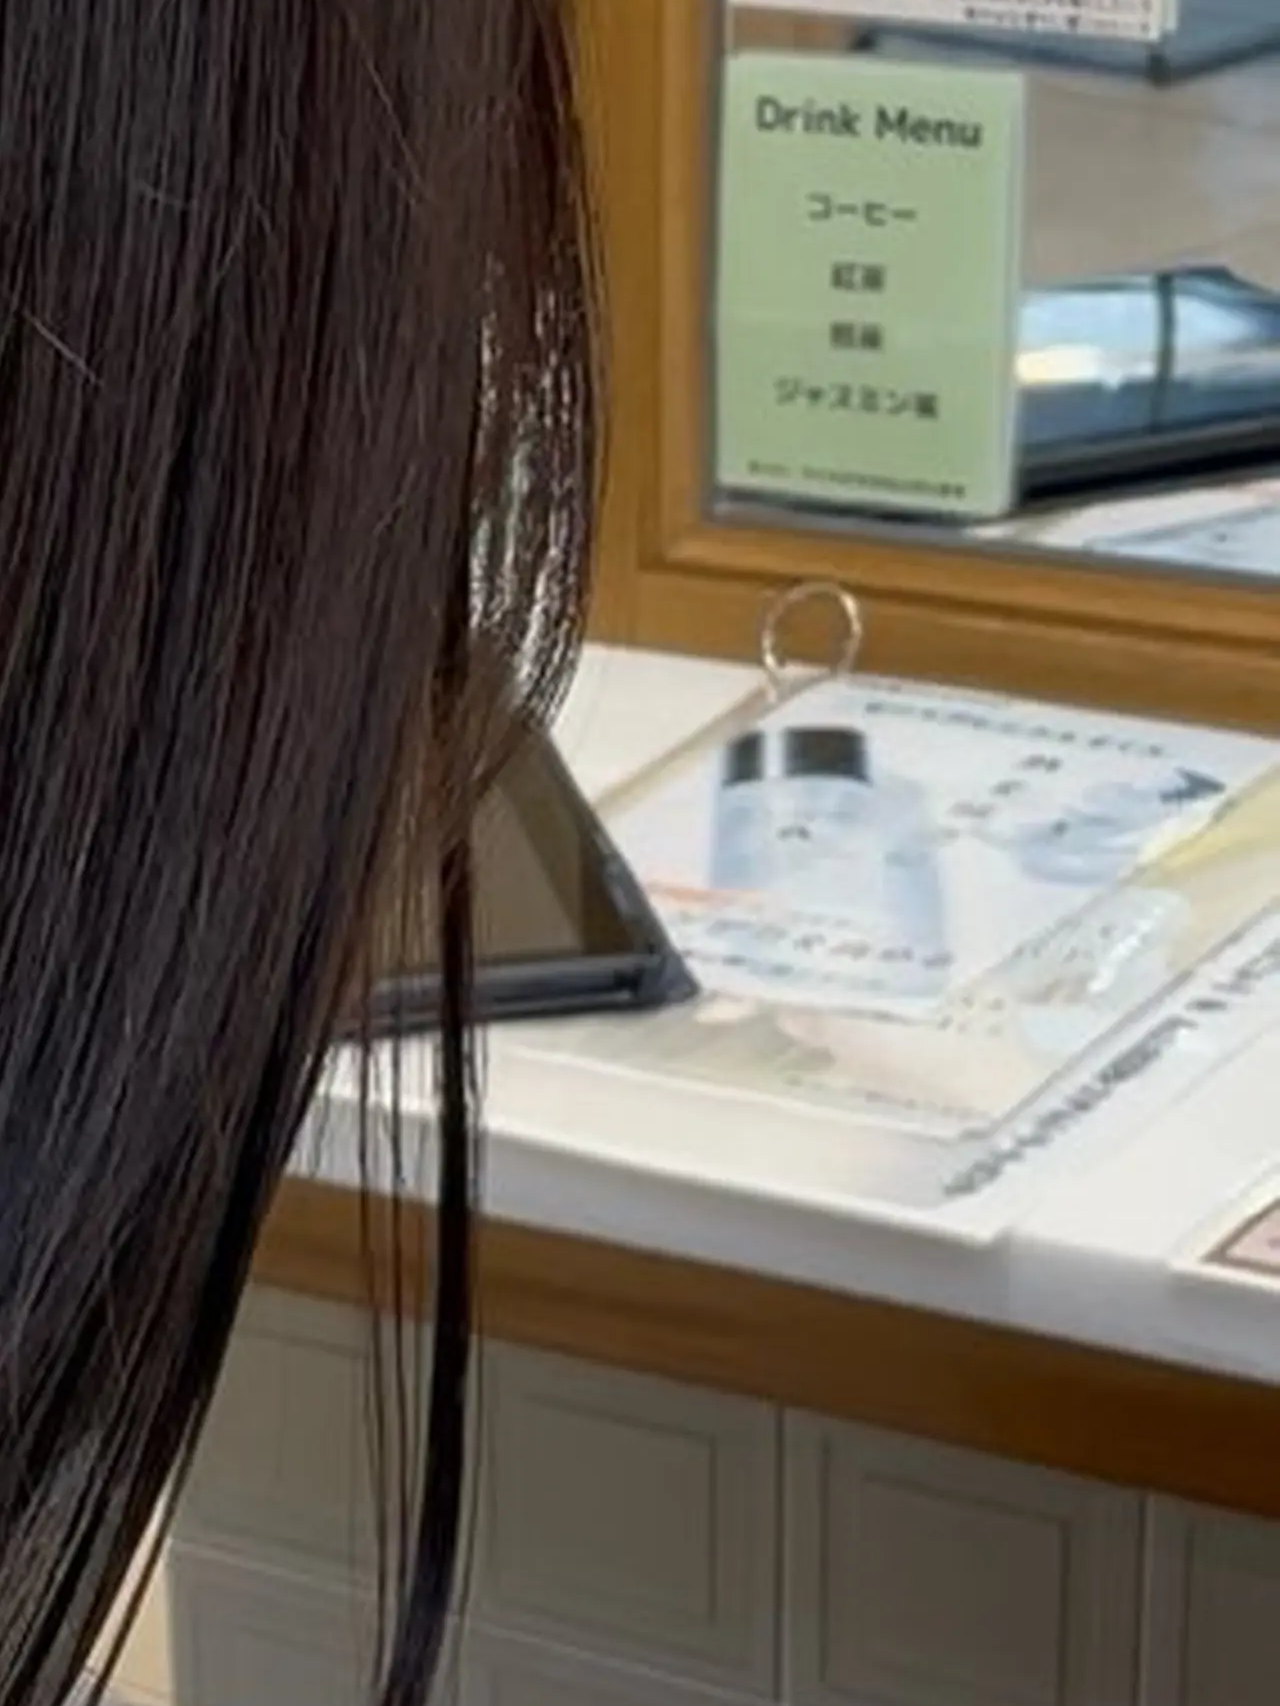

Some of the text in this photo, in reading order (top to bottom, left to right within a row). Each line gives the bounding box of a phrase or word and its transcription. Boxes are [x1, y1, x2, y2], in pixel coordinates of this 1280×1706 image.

[755, 94, 983, 150] Drink Menu
[806, 193, 917, 226] コーヒー
